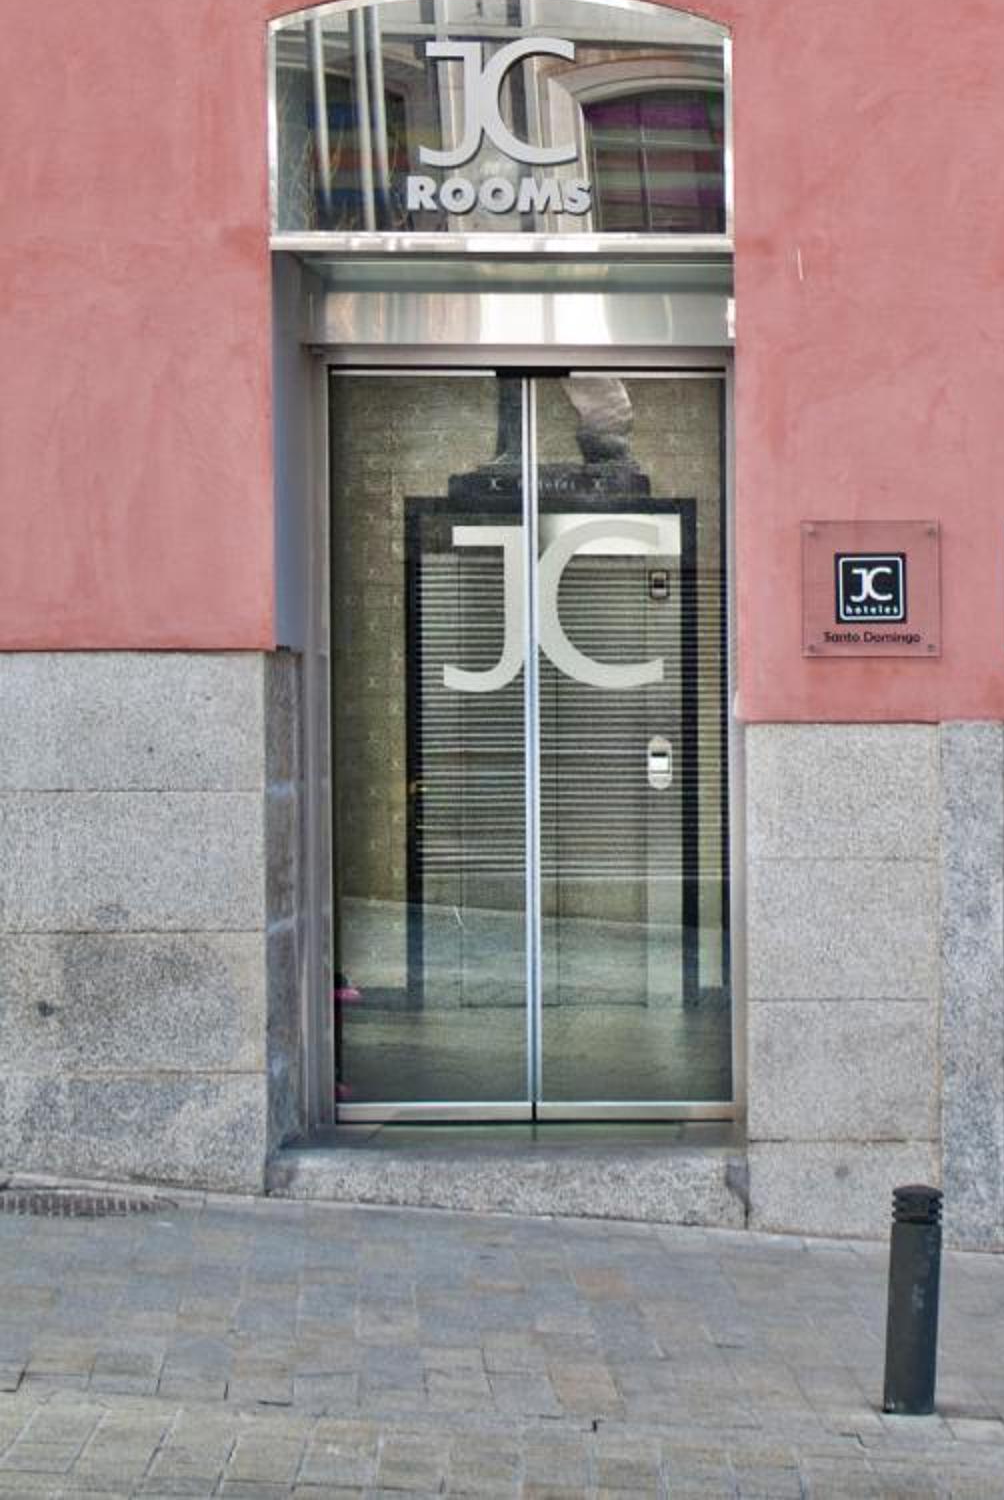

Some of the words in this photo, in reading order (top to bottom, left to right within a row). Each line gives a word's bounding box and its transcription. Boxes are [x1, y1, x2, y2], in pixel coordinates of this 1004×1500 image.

[419, 37, 579, 167] JC
[407, 176, 592, 215] ROOMS
[850, 566, 893, 603] JC
[444, 519, 664, 693] JC
[846, 604, 899, 615] hoteles
[823, 631, 861, 643] Santo
[863, 631, 921, 644] Domingo
